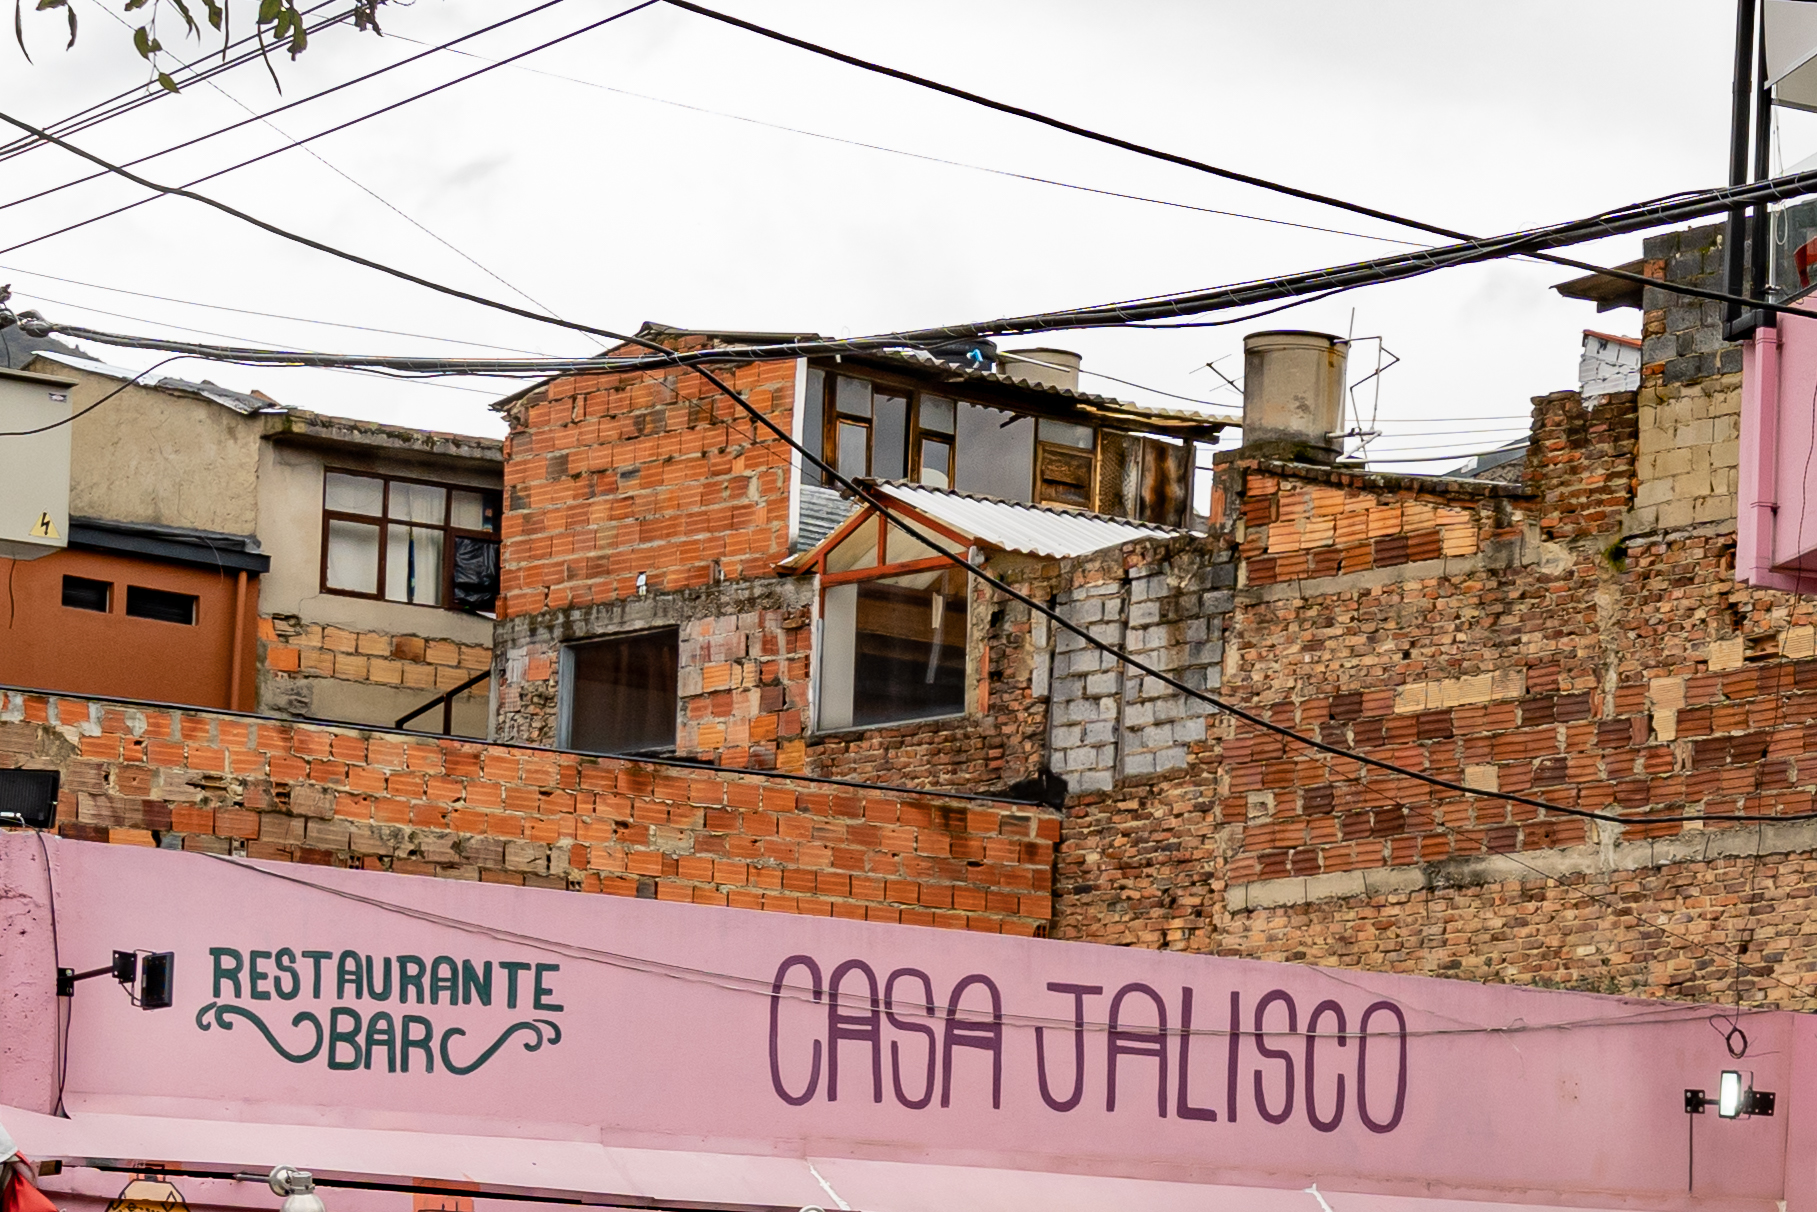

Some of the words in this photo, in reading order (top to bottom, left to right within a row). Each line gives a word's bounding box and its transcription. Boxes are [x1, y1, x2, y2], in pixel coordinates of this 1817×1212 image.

[209, 946, 565, 1013] RESTAURANTE
[327, 1006, 434, 1075] BAR
[768, 954, 1003, 1110] CASA
[1035, 981, 1408, 1135] JALISCO
